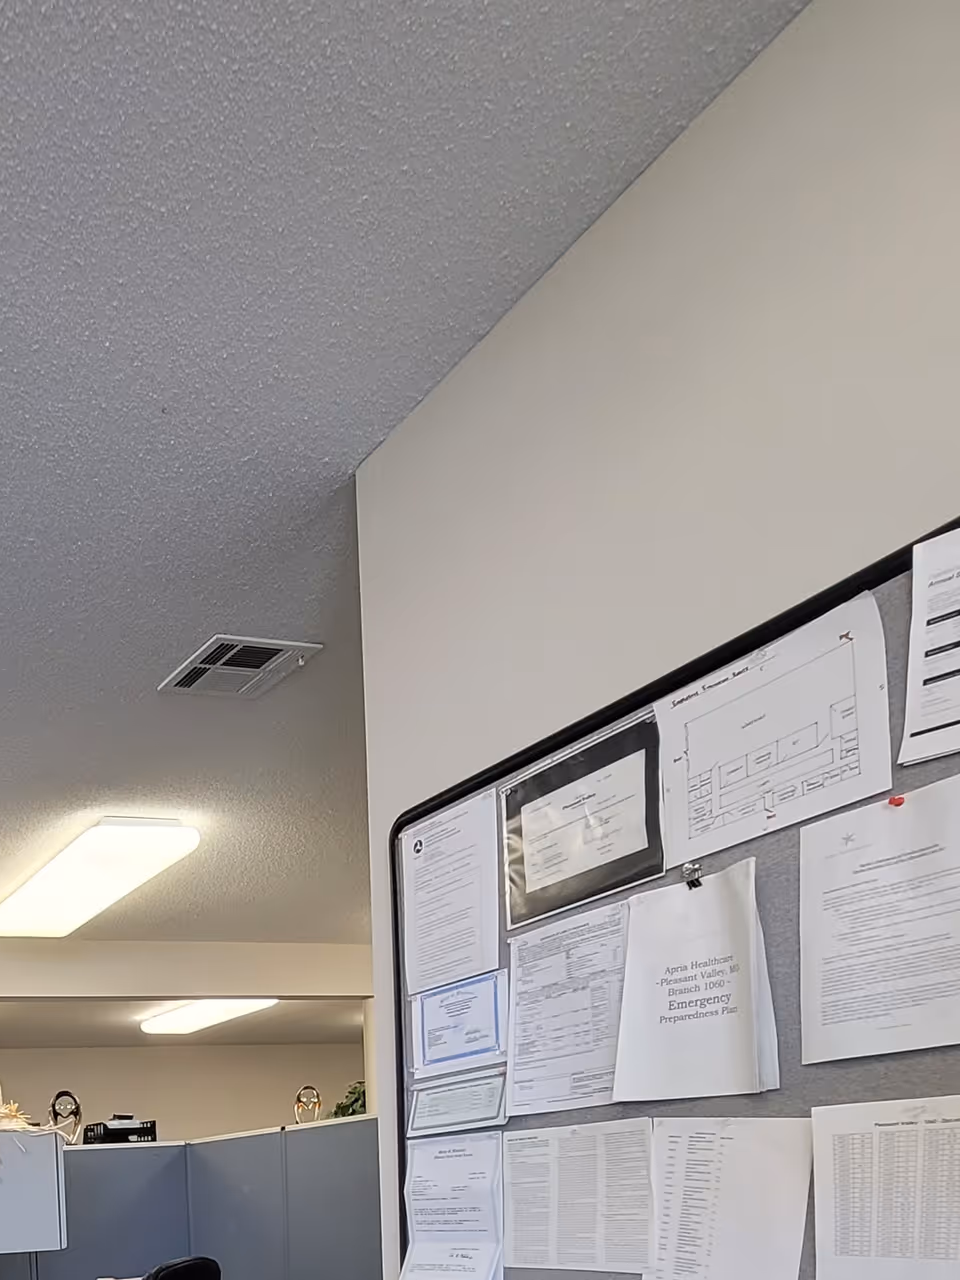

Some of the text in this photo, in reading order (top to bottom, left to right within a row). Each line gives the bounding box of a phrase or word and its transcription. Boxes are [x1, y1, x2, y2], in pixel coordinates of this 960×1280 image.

[664, 962, 688, 975] Apria
[667, 984, 701, 997] Branch
[704, 979, 725, 991] 1060
[668, 992, 732, 1012] Emergency
[659, 1007, 719, 1024] Preparedness
